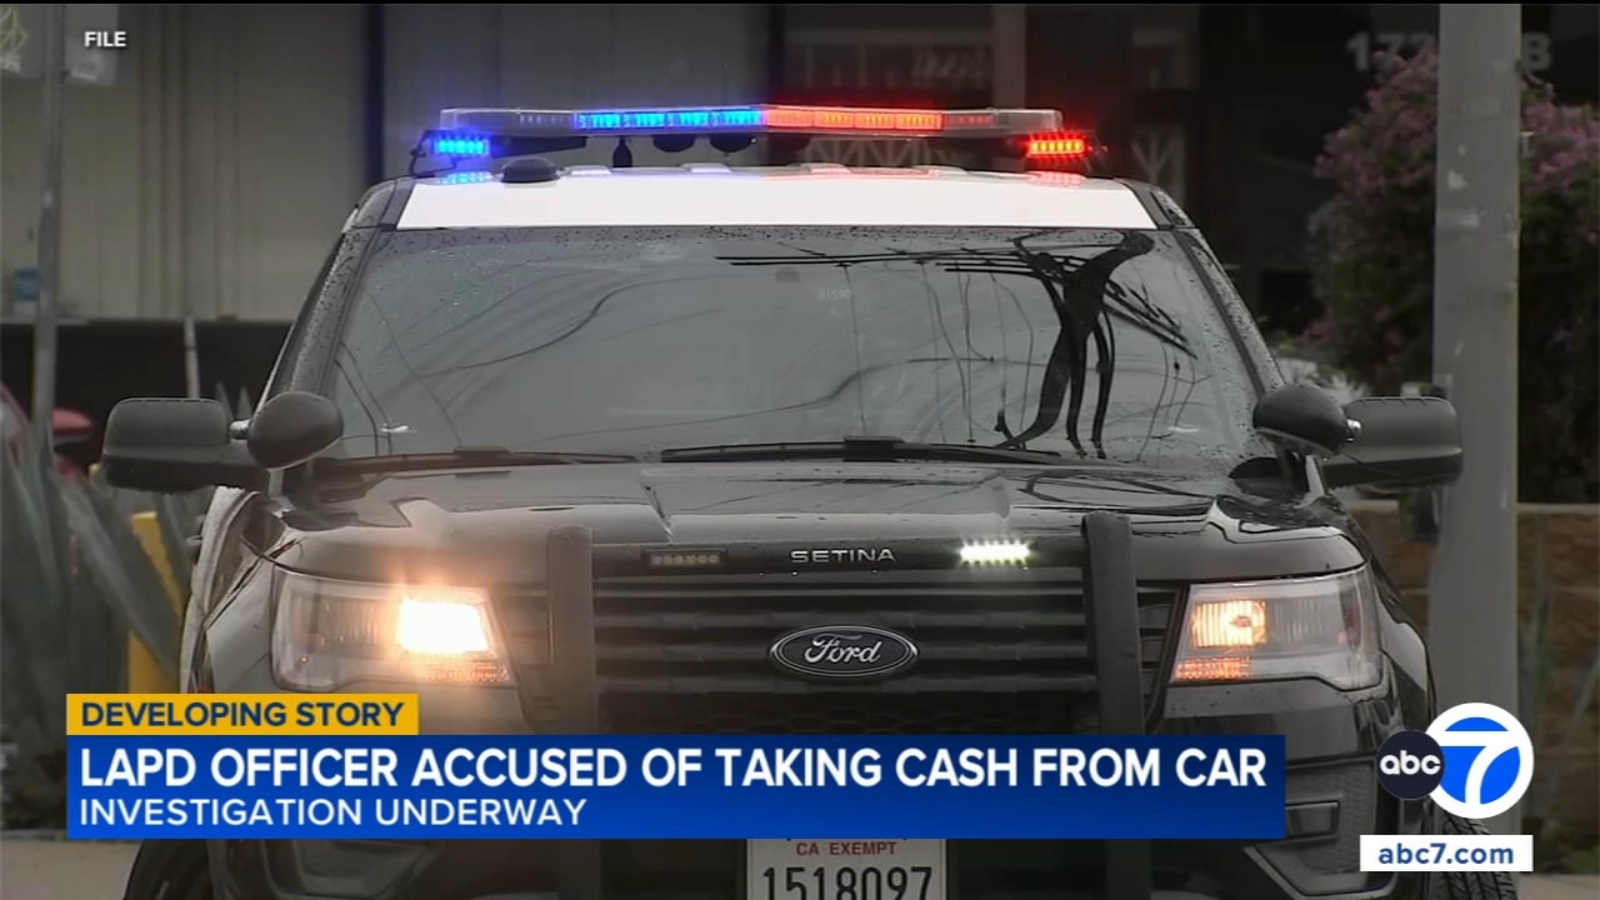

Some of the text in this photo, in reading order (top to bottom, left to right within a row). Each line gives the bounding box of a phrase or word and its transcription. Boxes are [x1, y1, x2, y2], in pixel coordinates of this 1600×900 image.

[790, 548, 896, 564] SETINA
[804, 633, 883, 665] Ford
[795, 841, 897, 856] CA EXEMPT
[763, 866, 932, 900] 1518097
